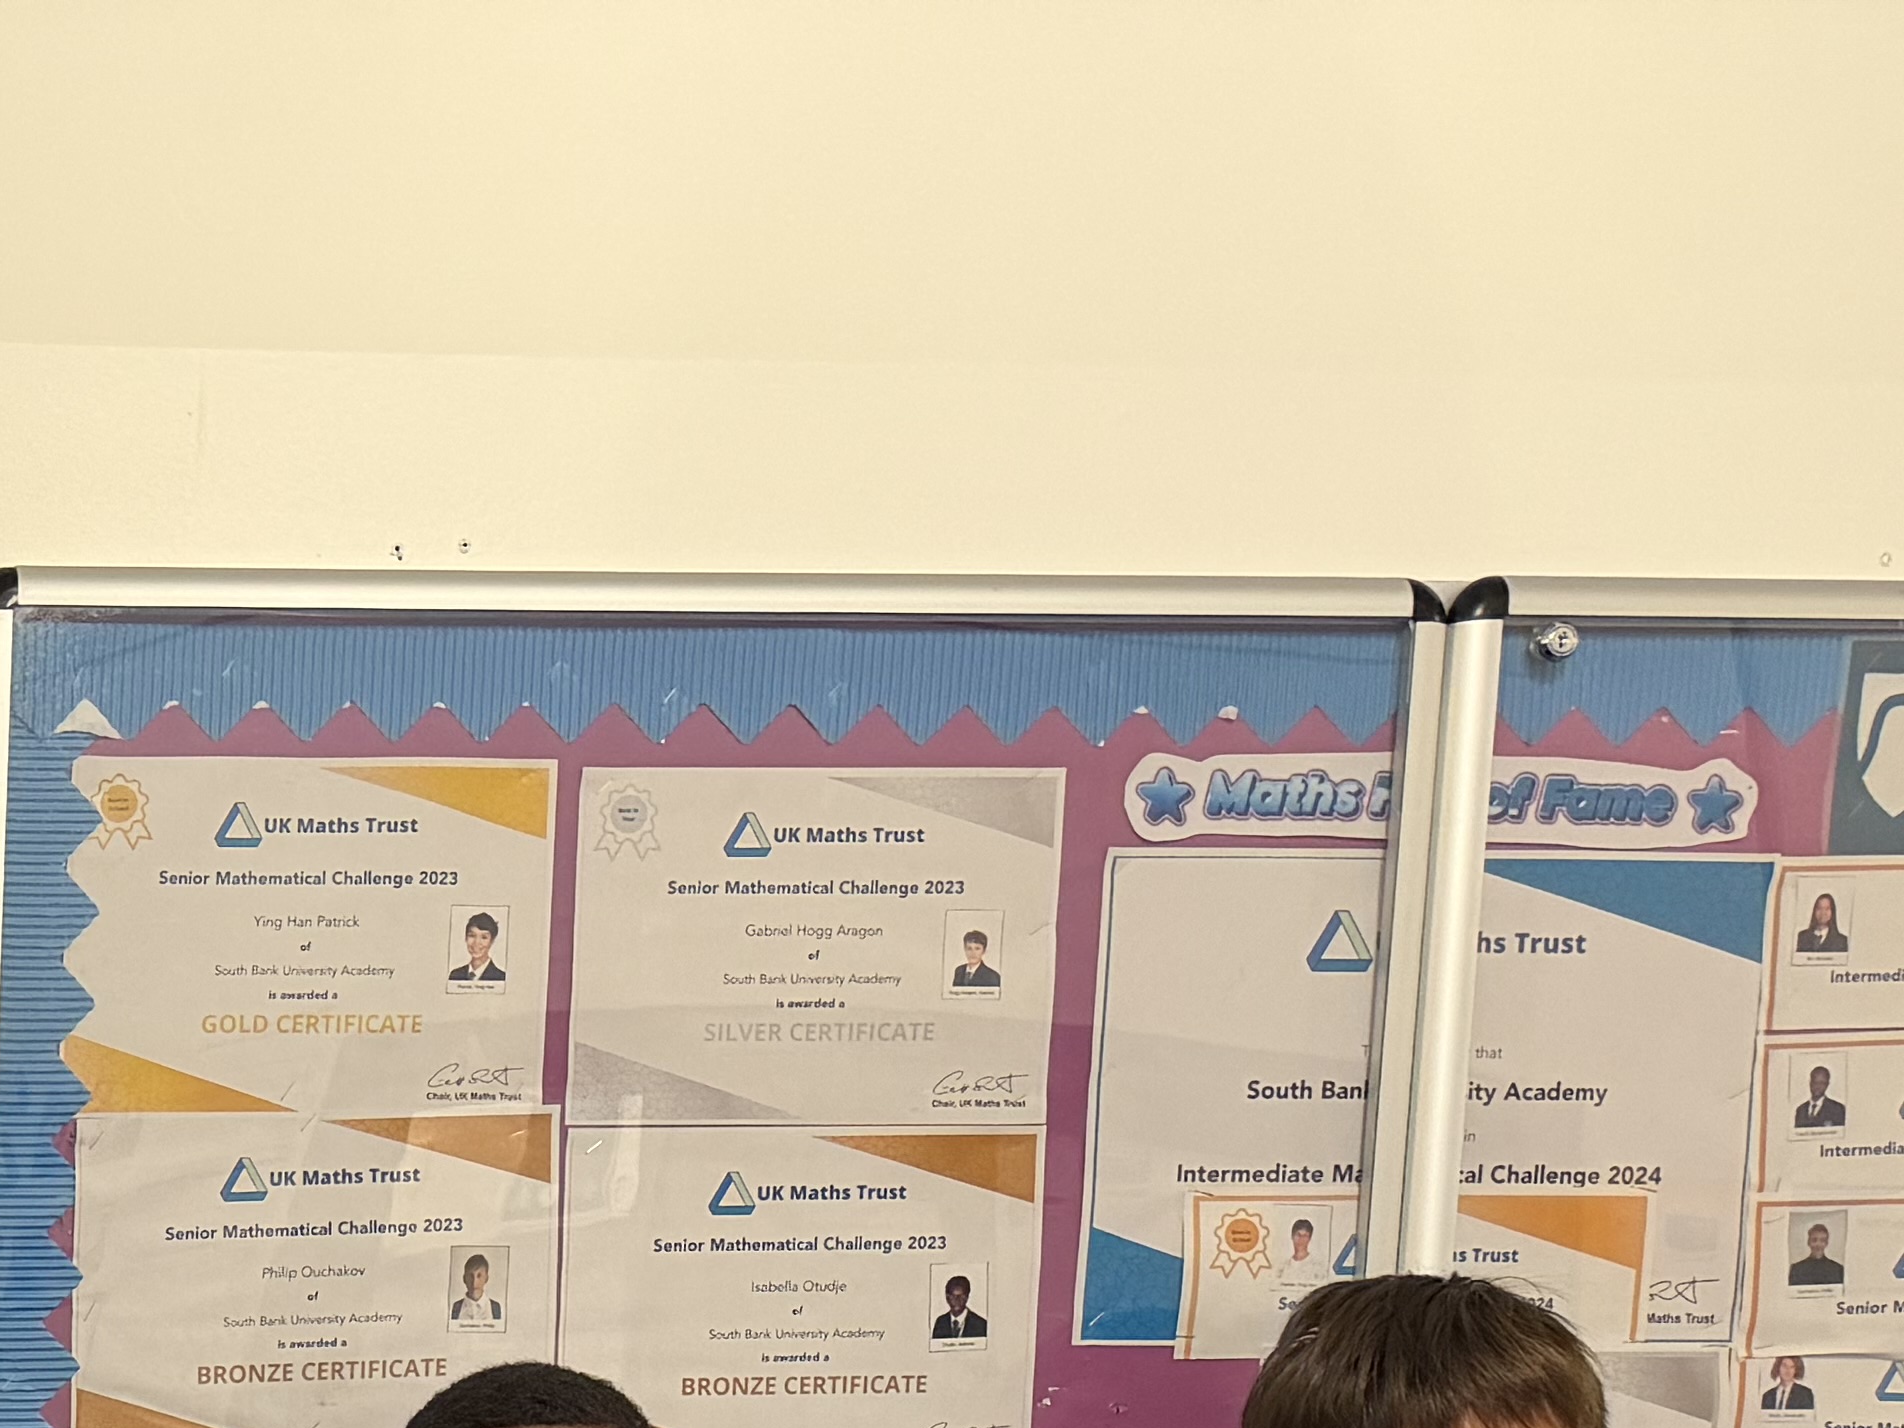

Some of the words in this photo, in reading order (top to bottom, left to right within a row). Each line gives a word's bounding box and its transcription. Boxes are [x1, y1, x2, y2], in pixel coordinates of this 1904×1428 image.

[1205, 771, 1362, 820] Maths
[1540, 775, 1676, 825] Fame
[265, 818, 291, 833] UK
[297, 817, 359, 833] Maths
[365, 818, 418, 833] Trust
[159, 870, 210, 884] Senior
[216, 871, 326, 885] Mathematical
[332, 870, 413, 888] Challenge
[419, 871, 457, 885] 2023
[254, 916, 282, 931] Ying
[287, 916, 312, 927] Han
[317, 915, 359, 927] Patrick
[745, 924, 792, 937] Gabriel
[797, 925, 832, 940] Hogg
[837, 925, 883, 940] Aragon
[202, 1015, 268, 1033] GOLD
[277, 1014, 422, 1034] CERTIFICATE
[704, 1023, 782, 1041] SILVER
[790, 1022, 935, 1042] CERTIFICATE
[1247, 1080, 1312, 1101] South
[1504, 1081, 1607, 1107] Academy
[262, 1266, 297, 1282] Philip
[752, 1280, 798, 1292] Isabella
[682, 1377, 776, 1396] BRONZE
[784, 1375, 927, 1395] CERTIFICATE
